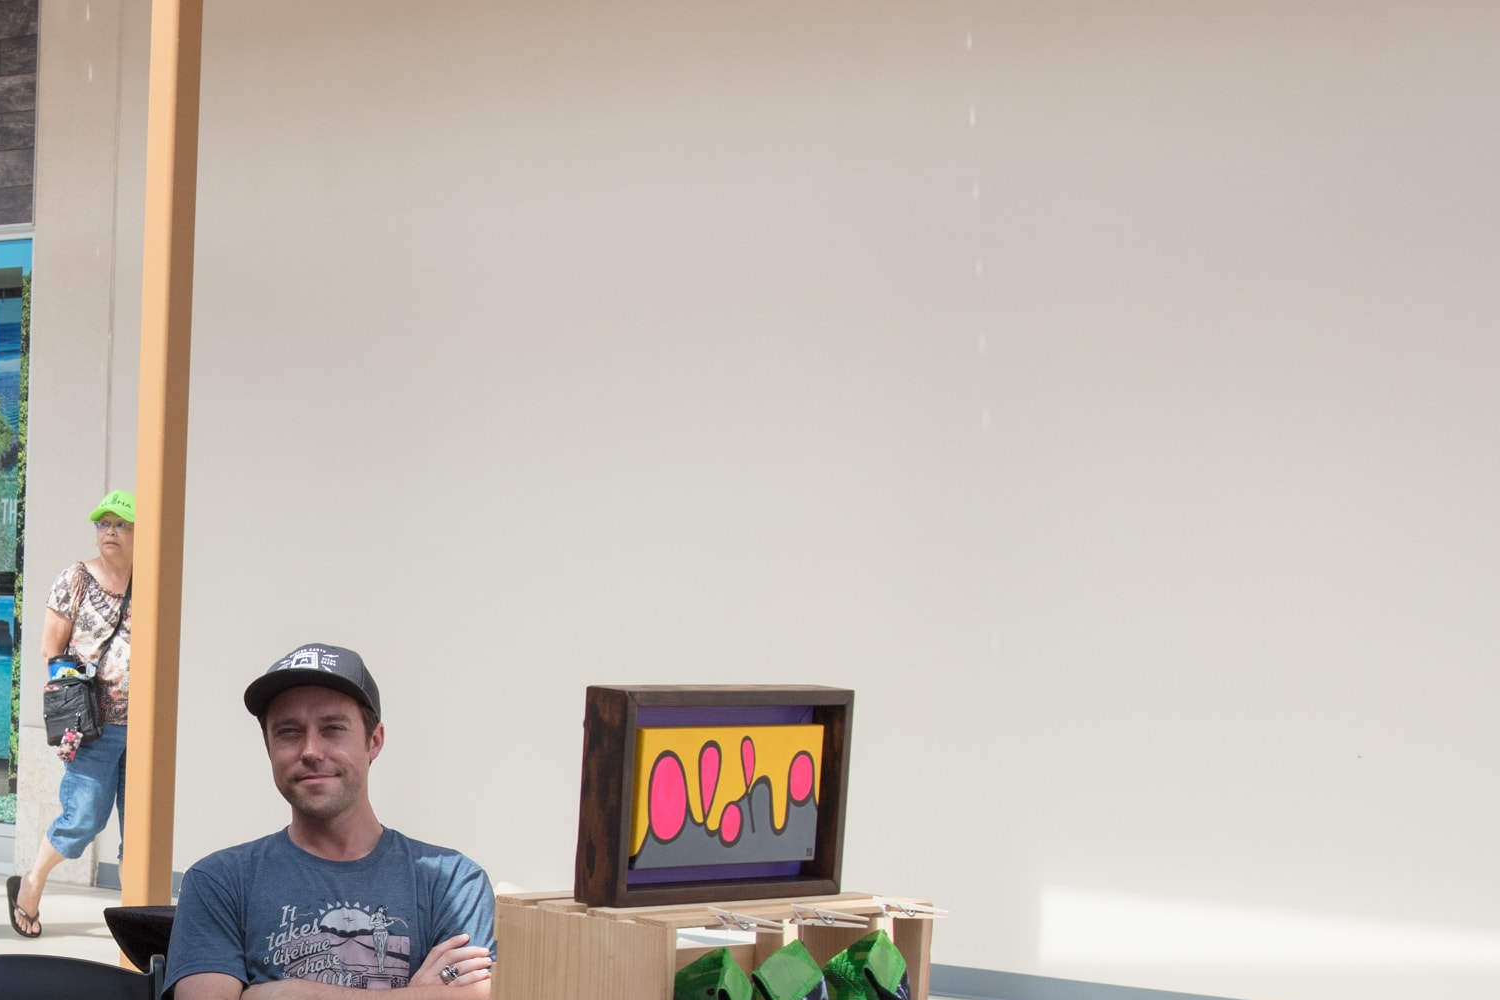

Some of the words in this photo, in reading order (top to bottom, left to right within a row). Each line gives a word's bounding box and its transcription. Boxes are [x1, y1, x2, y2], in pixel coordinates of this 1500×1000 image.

[279, 904, 297, 928] It
[266, 918, 321, 951] takes
[272, 938, 332, 966] lifetime
[296, 954, 341, 978] chase
